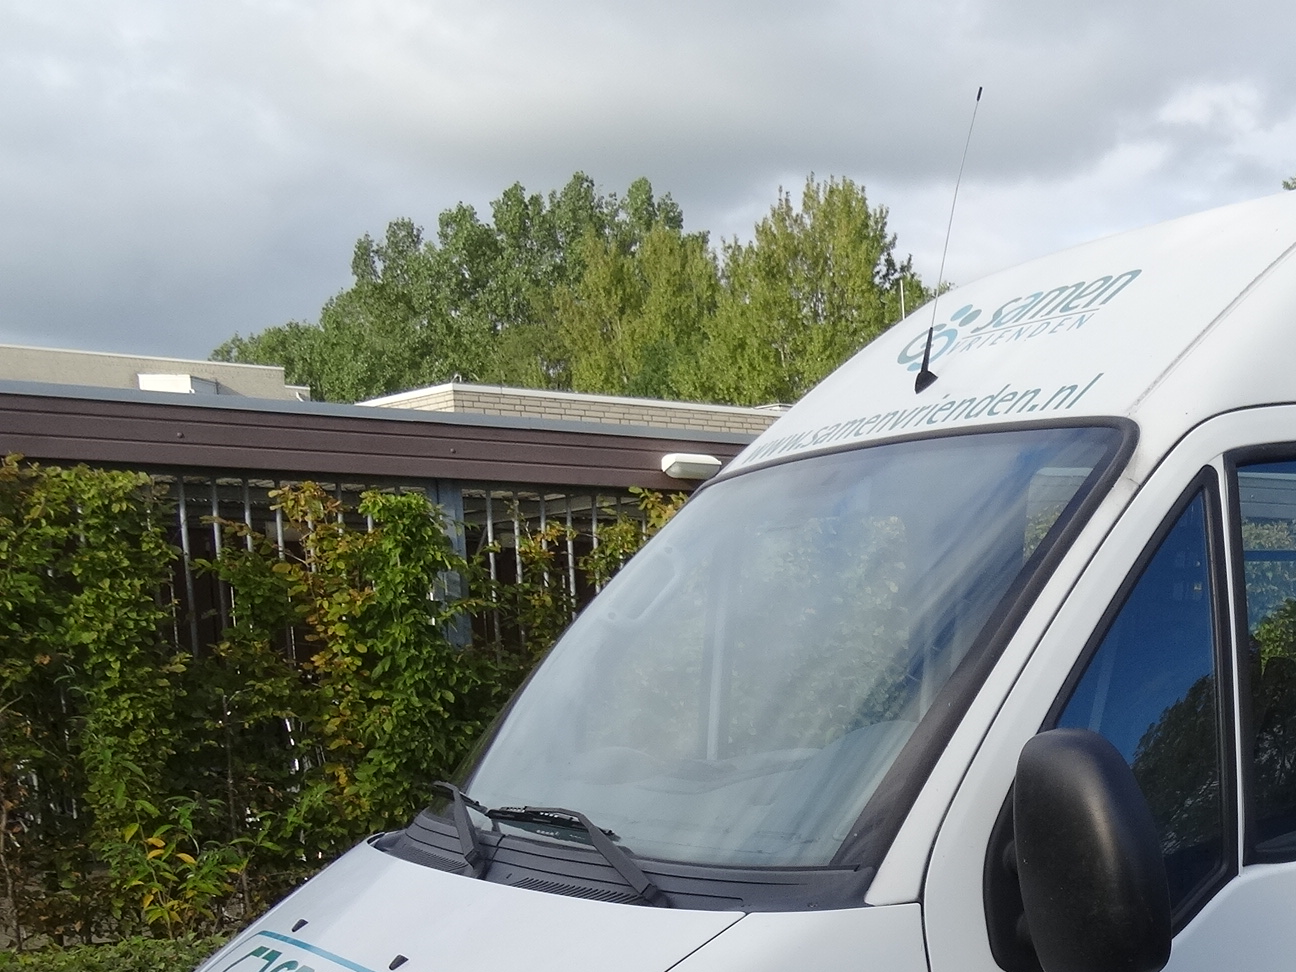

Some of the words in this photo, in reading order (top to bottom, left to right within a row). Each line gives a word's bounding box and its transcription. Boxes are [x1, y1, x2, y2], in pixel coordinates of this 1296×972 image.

[946, 312, 1095, 355] VRIENDEN
[970, 269, 1142, 334] samen
[742, 372, 1105, 464] www.samenvrienden.nl
